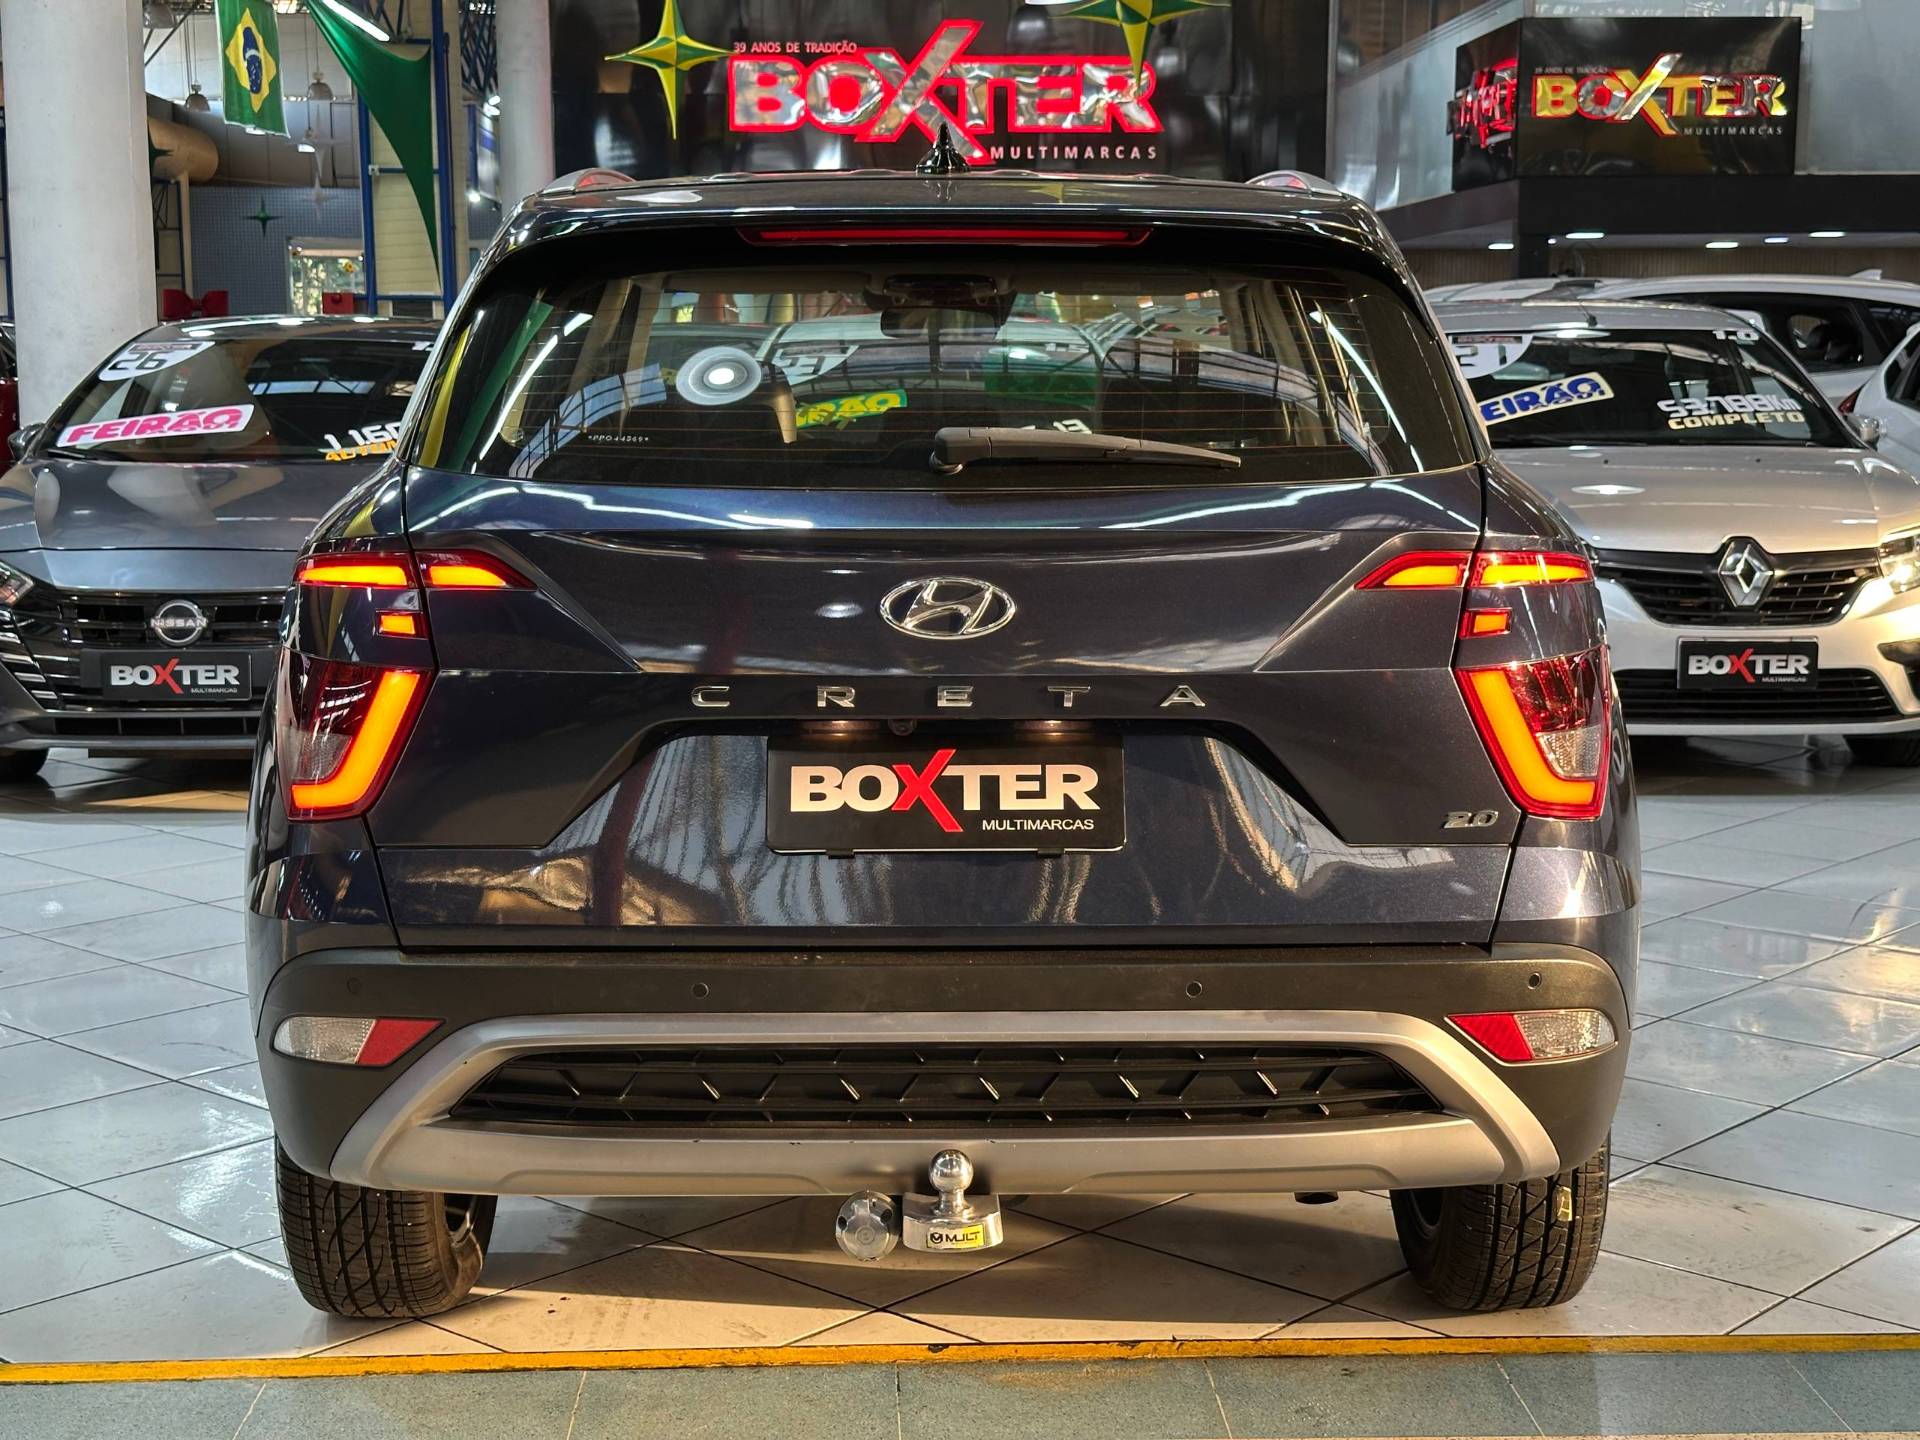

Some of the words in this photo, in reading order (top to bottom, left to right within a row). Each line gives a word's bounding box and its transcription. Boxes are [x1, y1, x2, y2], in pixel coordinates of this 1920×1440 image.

[733, 42, 747, 53] 39
[751, 42, 781, 53] ANOS
[786, 42, 800, 53] DE
[804, 40, 858, 55] TRADIÇÃO
[728, 19, 1163, 165] BOXTER
[1532, 52, 1788, 137] BOXTER
[1683, 126, 1783, 136] MULTIMARCAS
[990, 146, 1157, 159] MULTIMARCAS
[108, 351, 167, 371] 26
[67, 408, 243, 443] FEIRÃO
[1667, 411, 1805, 430] COMPLETO
[150, 617, 207, 628] NISSAN
[110, 656, 240, 695] BOXTER
[1687, 647, 1810, 683] BOXTER
[692, 685, 1206, 708] CRETA
[790, 748, 1101, 834] BOXTER
[981, 819, 1095, 831] MULTIMARCAS
